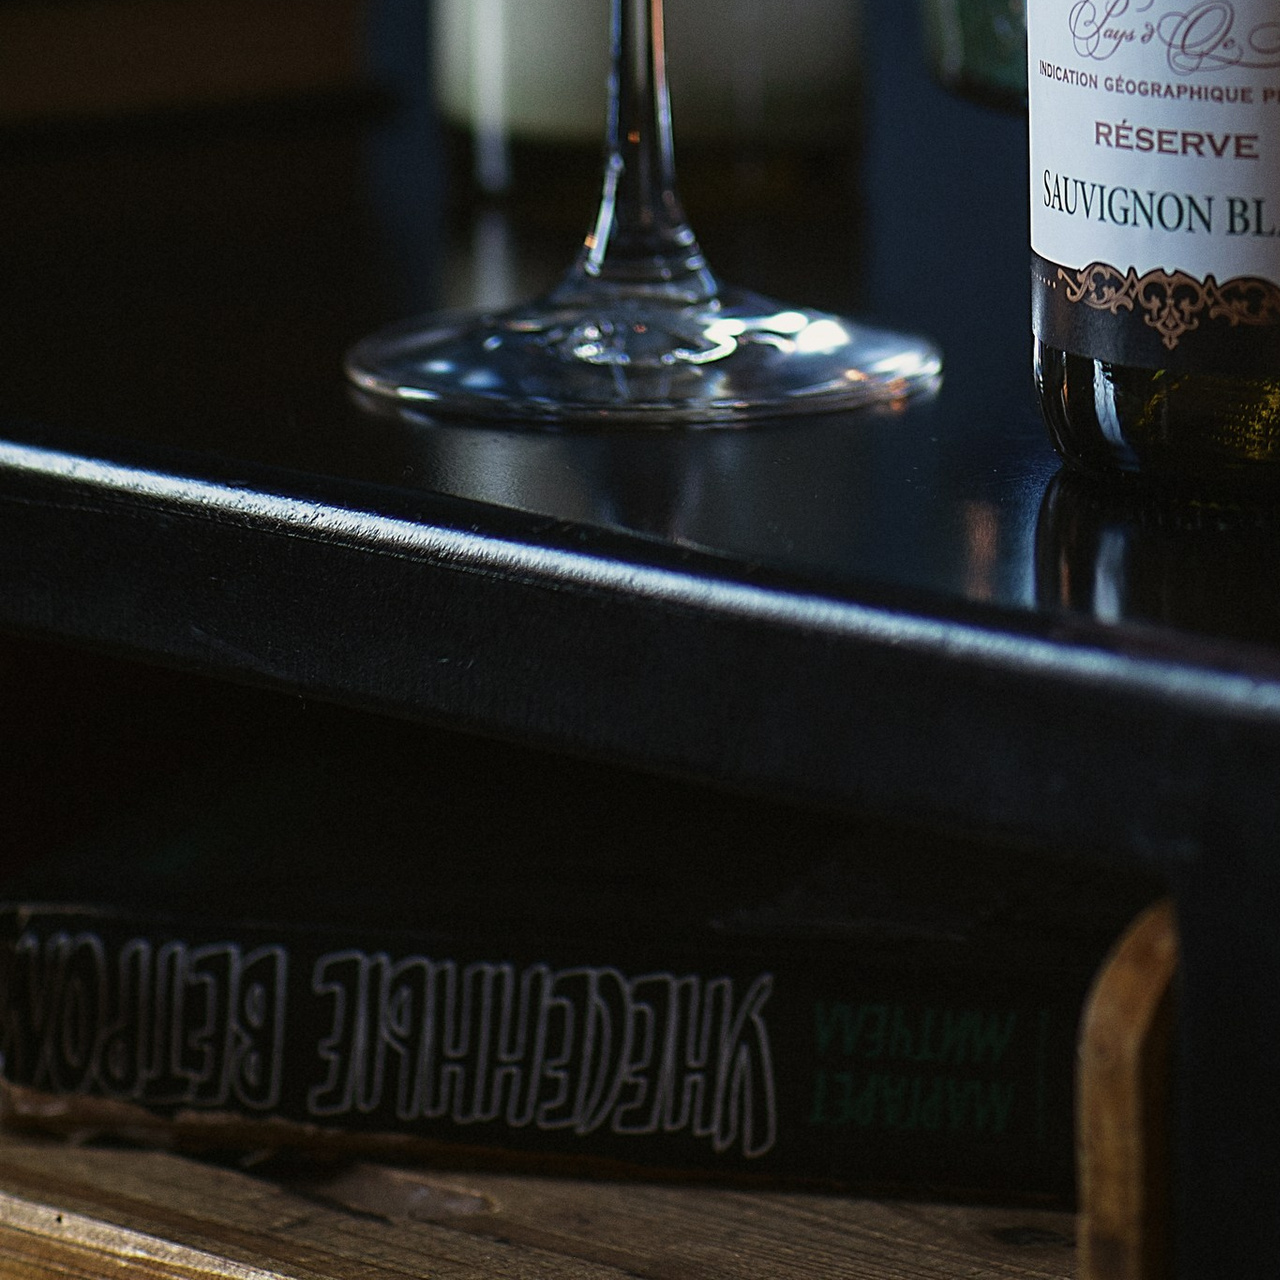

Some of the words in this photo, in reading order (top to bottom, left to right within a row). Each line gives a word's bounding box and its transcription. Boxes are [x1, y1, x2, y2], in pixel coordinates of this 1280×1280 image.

[1038, 59, 1099, 90] INDICATION
[1104, 75, 1253, 104] GÉOGRAPHIQUE
[1094, 119, 1260, 160] RÉSERVE
[1043, 168, 1214, 235] SAUVIGNON
[808, 1068, 1018, 1136] МАРГАРЕТ
